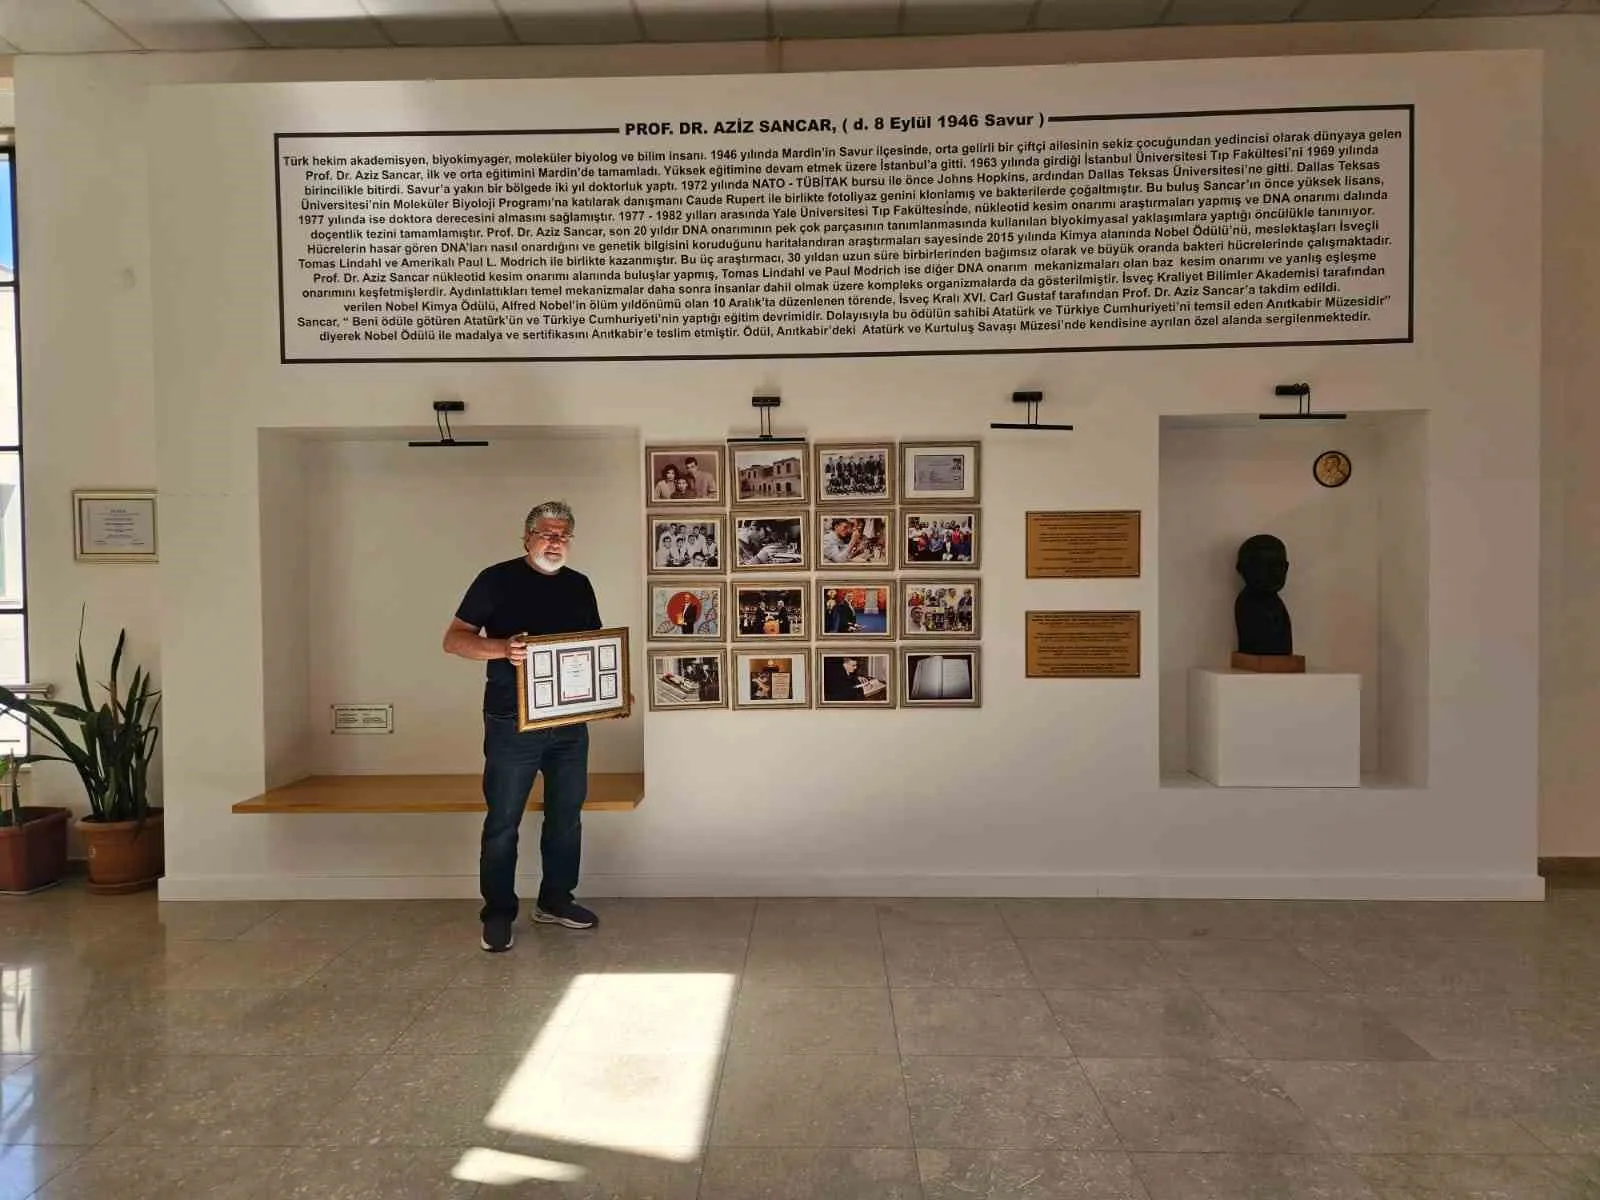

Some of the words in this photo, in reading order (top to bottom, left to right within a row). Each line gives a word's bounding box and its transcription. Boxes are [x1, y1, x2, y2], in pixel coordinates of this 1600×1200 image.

[625, 122, 674, 136] PROF.
[679, 121, 708, 135] DR.
[713, 118, 754, 134] AZİZ
[759, 118, 837, 133] SANCAR,
[842, 117, 848, 134] (
[853, 117, 868, 130] d.
[874, 117, 885, 130] 8
[890, 116, 931, 132] Eylül
[937, 114, 979, 128] 1946
[984, 113, 1034, 127] Savur
[1038, 112, 1045, 128] )
[282, 155, 309, 165] Türk
[312, 155, 347, 165] hekim
[350, 154, 431, 167] akademisyen,
[432, 153, 514, 166] biyokimyager,
[513, 152, 572, 162] moleküler
[574, 151, 618, 164] biyolog
[620, 153, 634, 161] ve
[637, 150, 665, 160] bilim
[668, 149, 707, 160] insanı.
[710, 149, 737, 159] 1946
[738, 148, 779, 161] yılında
[781, 146, 836, 157] Mardin'in
[837, 146, 874, 156] Savur
[875, 144, 931, 157] ilçesinde,
[935, 144, 960, 153] orta
[961, 142, 994, 155] gelirli
[997, 141, 1014, 152] bir
[1016, 140, 1046, 153] çiftçi
[1047, 139, 1099, 150] ailesinin
[1101, 137, 1135, 148] sekiz
[1134, 134, 1211, 150] çocuğundan
[1214, 132, 1269, 147] yedincisi
[1272, 131, 1311, 142] olarak
[1311, 128, 1366, 143] dünyaya
[1367, 127, 1401, 141] gelen
[304, 184, 364, 194] birincilikle
[366, 184, 403, 194] bitirdi.
[406, 184, 450, 193] Savur'a
[453, 183, 486, 195] yakın
[486, 183, 504, 192] bir
[505, 182, 554, 195] bölgede
[554, 182, 568, 191] iki
[571, 182, 585, 194] yıl
[587, 181, 643, 191] doktorluk
[645, 181, 677, 192] yaptı.
[680, 180, 708, 189] 1972
[710, 178, 749, 191] yılında
[750, 178, 785, 188] NATO
[795, 174, 848, 187] TÜBİTAK
[851, 175, 885, 186] bursu
[888, 175, 903, 185] ile
[903, 174, 935, 184] önce
[936, 173, 975, 183] Johns
[974, 171, 1031, 185] Hopkins,
[1031, 169, 1084, 181] ardından
[1087, 168, 1124, 179] Dallas
[1127, 166, 1172, 178] Teksas
[1264, 162, 1293, 175] gitti.
[1296, 160, 1336, 172] Dallas
[1336, 158, 1380, 170] Teksas
[298, 214, 324, 224] 1977
[326, 214, 366, 226] yılında
[368, 214, 385, 223] ise
[388, 213, 432, 223] doktora
[435, 212, 495, 223] derecesini
[497, 212, 546, 222] almasını
[546, 211, 615, 224] sağlamıştır.
[618, 211, 645, 220] 1977
[655, 210, 684, 220] 1982
[684, 209, 717, 221] yılları
[717, 208, 769, 218] arasında
[770, 207, 797, 217] Yale
[798, 204, 868, 217] Üniversitesi
[871, 206, 892, 218] Tıp
[893, 203, 973, 216] Fakültesinde,
[973, 201, 1030, 212] nükleotid
[1031, 200, 1068, 211] kesim
[1071, 201, 1115, 210] onarımı
[1117, 196, 1194, 211] araştırmaları
[1197, 197, 1242, 208] yapmış
[1243, 196, 1259, 204] ve
[1262, 193, 1291, 203] DNA
[1292, 193, 1339, 202] onarımı
[1341, 189, 1387, 200] dalında
[307, 243, 366, 253] Hücrelerin
[369, 243, 402, 252] hasar
[404, 243, 438, 254] gören
[439, 242, 488, 252] DNA'ları
[490, 241, 519, 251] nasıl
[520, 241, 579, 253] onardığını
[598, 240, 640, 252] genetik
[644, 239, 688, 252] bilgisini
[692, 238, 762, 251] koruduğunu
[765, 236, 847, 247] haritalandıran
[846, 234, 923, 248] araştırmaları
[922, 232, 984, 246] sayesinde
[986, 232, 1015, 242] 2015
[1015, 230, 1056, 244] yılında
[1059, 229, 1099, 242] Kimya
[1100, 227, 1151, 239] alanında
[1154, 226, 1191, 237] Nobel
[1191, 222, 1251, 238] Ödülü'nü,
[1254, 221, 1335, 236] meslektaşları
[1339, 218, 1379, 233] İsveçli
[359, 286, 446, 298] keşfetmişlerdir.
[448, 285, 527, 298] Aydınlattıkları
[530, 285, 562, 295] temel
[565, 284, 646, 294] mekanizmalar
[647, 283, 675, 293] daha
[678, 285, 711, 293] sonra
[713, 282, 762, 292] insanlar
[761, 281, 791, 291] dahil
[794, 280, 831, 291] olmak
[832, 280, 864, 290] üzere
[867, 278, 925, 292] kompleks
[924, 276, 1016, 290] organizmalarda
[1019, 276, 1034, 286] da
[1037, 273, 1120, 288] gösterilmiştir.
[1122, 271, 1155, 285] İsveç
[1155, 271, 1203, 284] Kraliyet
[1206, 269, 1255, 280] Bilimler
[1254, 267, 1319, 279] Akademisi
[1320, 264, 1384, 276] tarafından
[319, 330, 360, 342] diyerek
[364, 330, 397, 339] Nobel
[400, 328, 437, 339] Ödülü
[438, 329, 452, 339] ile
[455, 329, 503, 341] madalya
[522, 328, 590, 338] sertifikasını
[654, 327, 691, 337] teslim
[694, 326, 739, 339] etmiştir.
[742, 324, 773, 337] Ödül,
[861, 323, 904, 334] Atatürk
[907, 325, 921, 333] ve
[924, 322, 976, 335] Kurtuluş
[975, 321, 1016, 334] Savaşı
[1087, 317, 1147, 328] kendisine
[1149, 316, 1190, 329] ayrılan
[1194, 315, 1218, 325] özel
[1221, 313, 1262, 324] alanda
[1263, 310, 1370, 326] sergilenmektedir.
